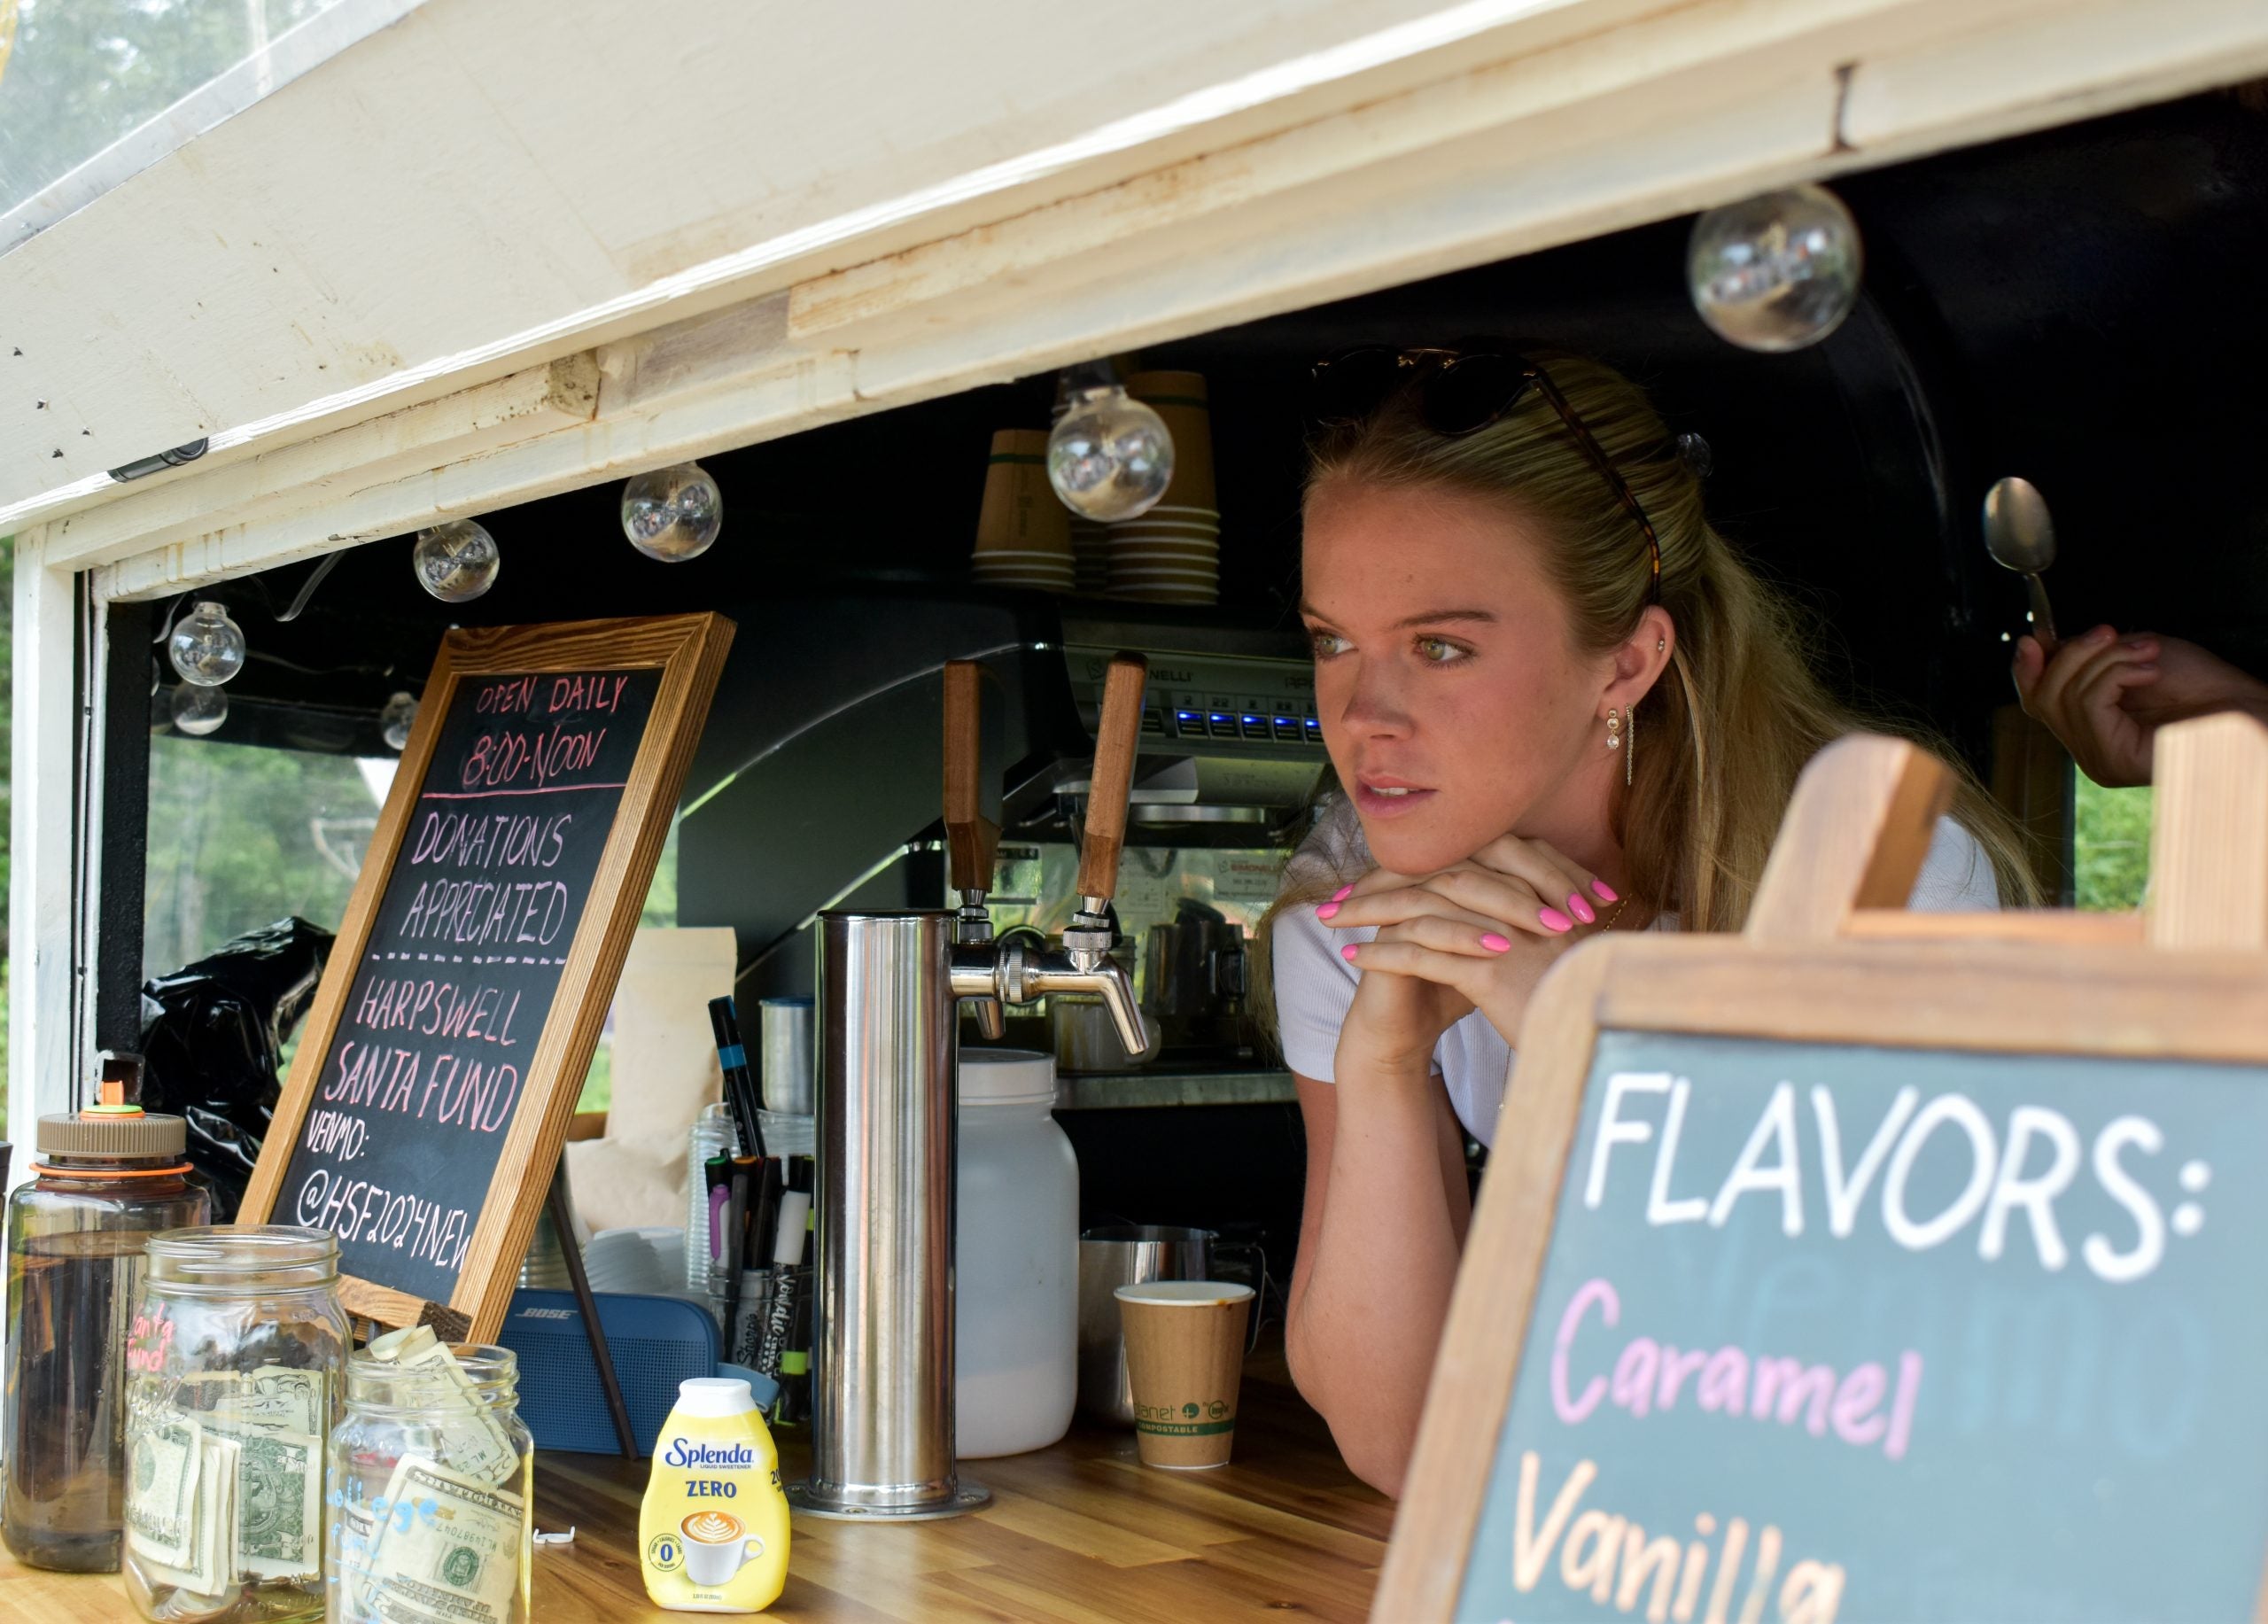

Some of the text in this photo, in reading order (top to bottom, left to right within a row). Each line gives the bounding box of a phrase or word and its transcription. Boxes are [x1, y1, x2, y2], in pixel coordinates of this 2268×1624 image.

[476, 674, 628, 714] OPEN DAILY
[1148, 669, 1193, 682] NELLI
[412, 812, 571, 868] DONATIONS
[400, 878, 568, 945] APPRECIATED
[355, 975, 521, 1046] HARPSWELL
[324, 1040, 518, 1132] SANTA FUND
[307, 1109, 369, 1162] VENMO:
[1584, 1071, 2212, 1285] FLAVORS:
[515, 1308, 579, 1319] BOSE
[1550, 1277, 1924, 1462] Caramel
[664, 1437, 753, 1468] Splenda
[686, 1480, 737, 1498] ZERO
[660, 1543, 673, 1562] 0
[1513, 1449, 1846, 1624] Vanilla
